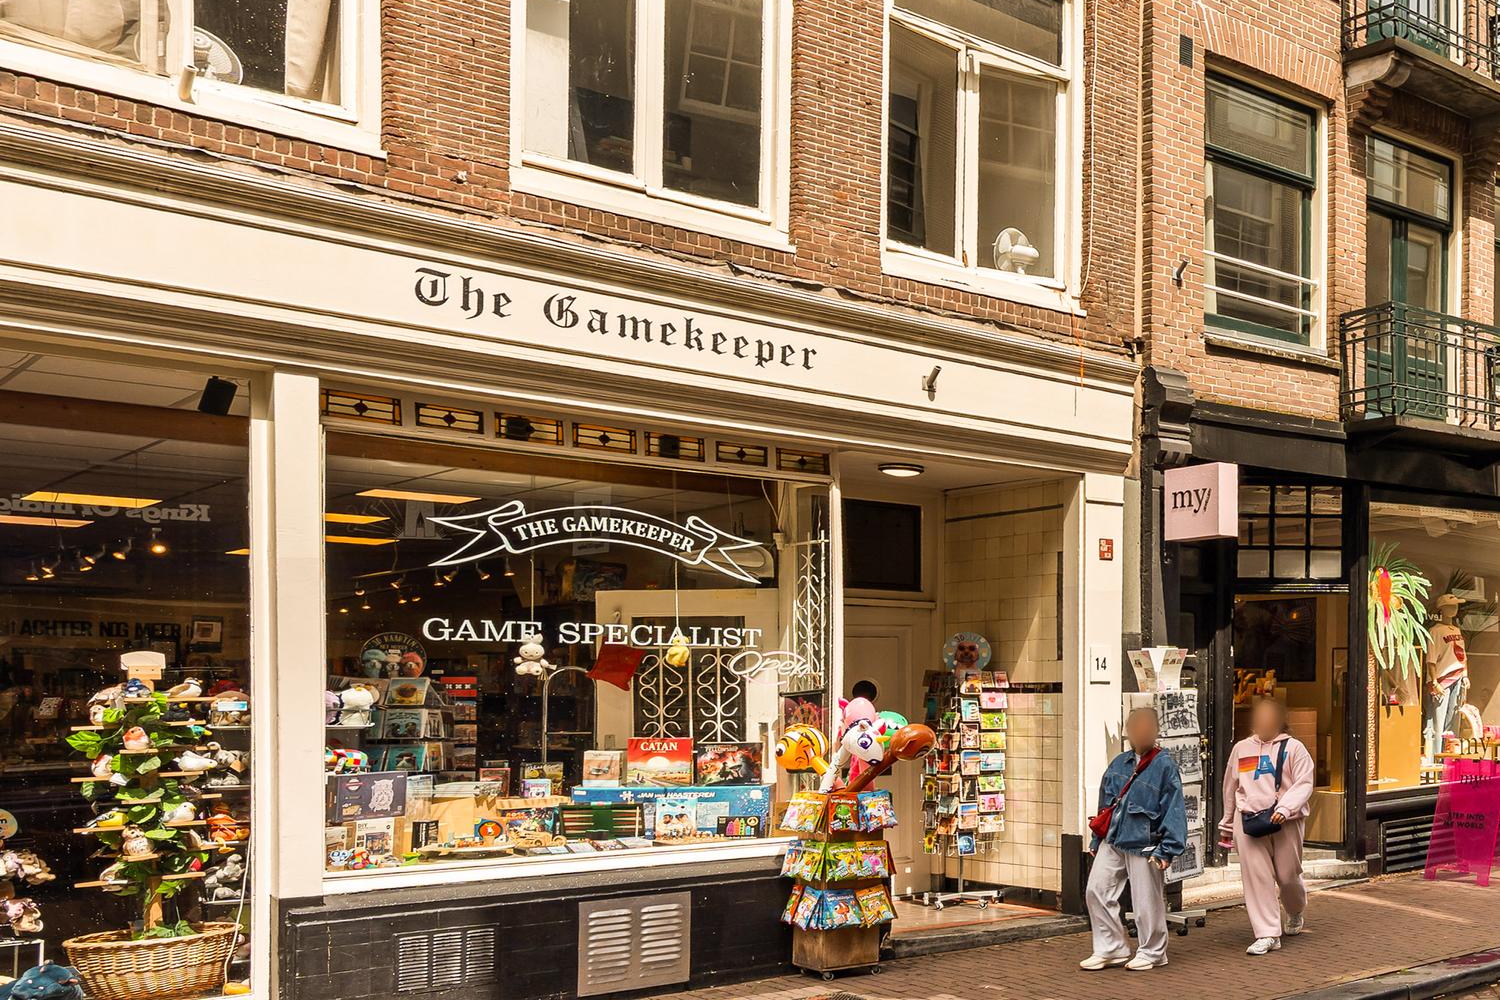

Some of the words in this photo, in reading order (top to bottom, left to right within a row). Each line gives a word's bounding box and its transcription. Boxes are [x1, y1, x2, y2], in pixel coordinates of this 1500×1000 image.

[414, 267, 512, 320] The
[543, 293, 817, 370] Gamekeeper
[1171, 488, 1207, 513] my
[512, 517, 558, 542] THE
[562, 516, 696, 552] GAMEKEEPER
[422, 618, 542, 642] GAME
[558, 621, 762, 648] SPECIALIST
[1095, 657, 1107, 670] 14
[640, 742, 679, 751] CATAN
